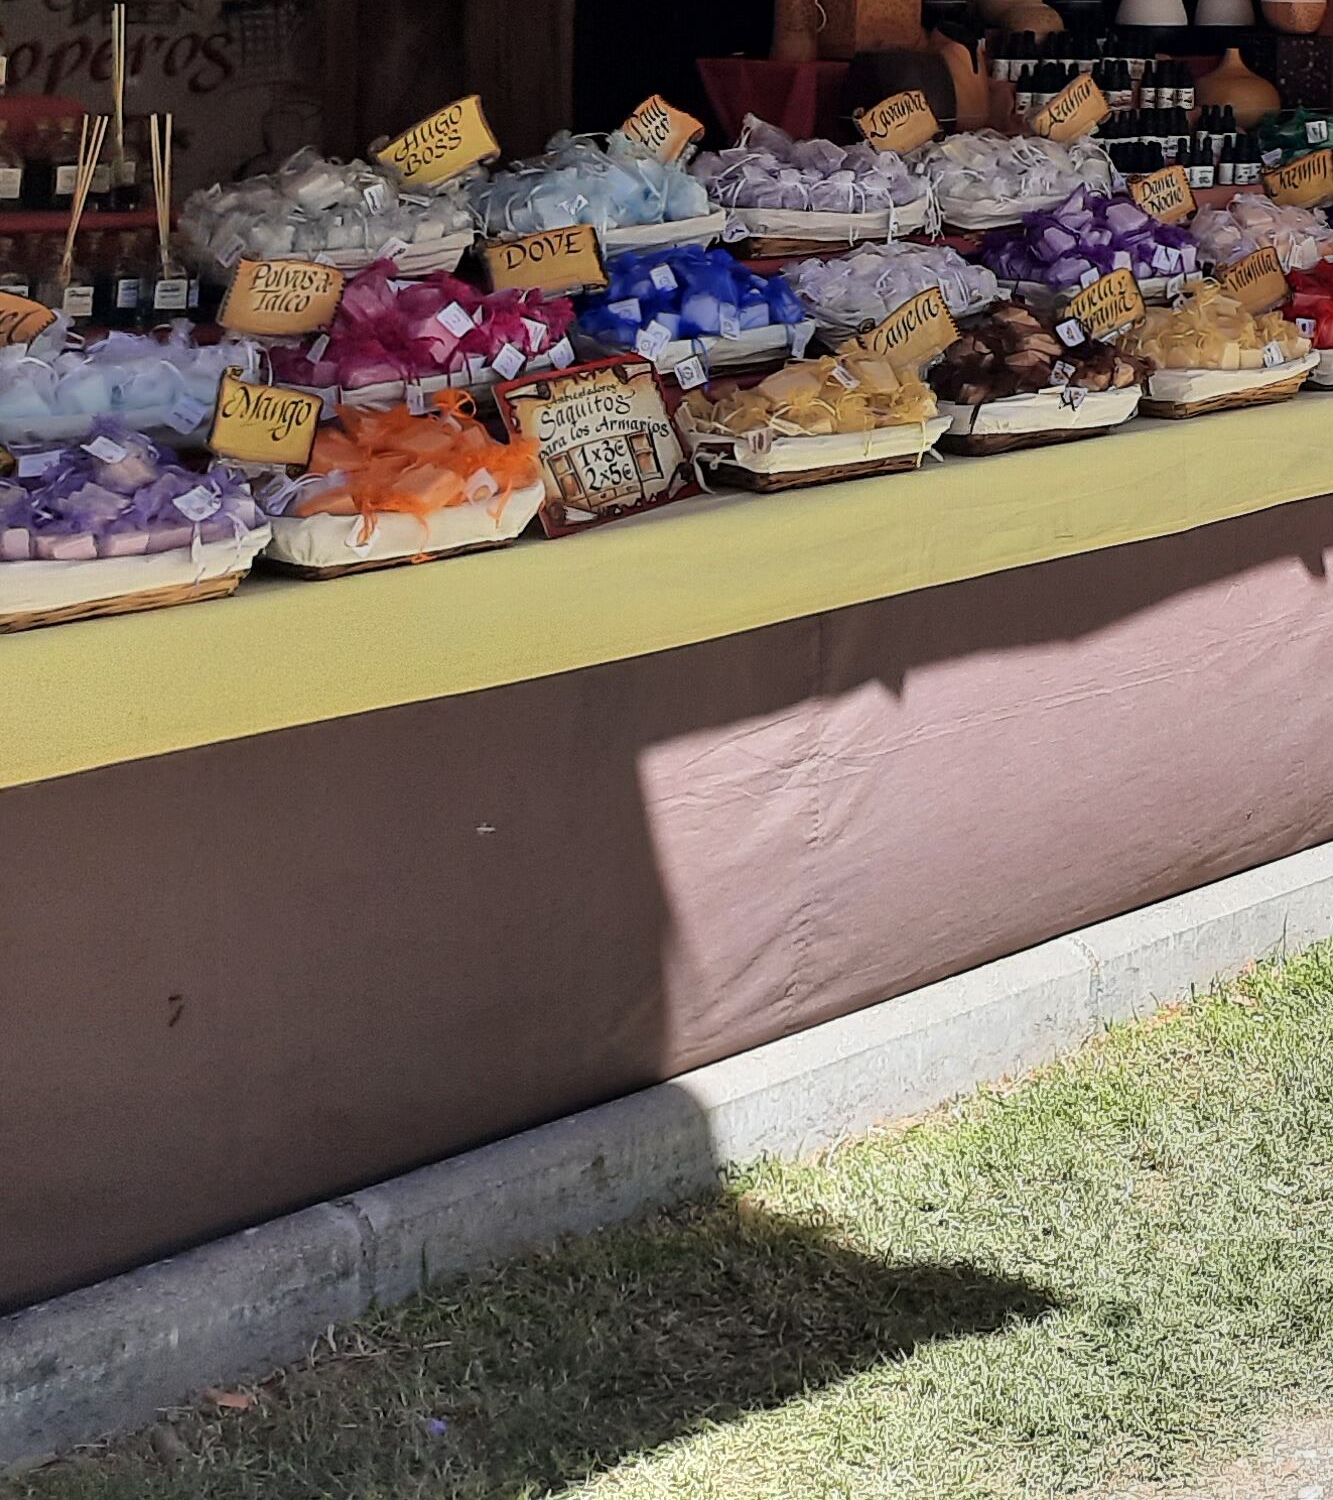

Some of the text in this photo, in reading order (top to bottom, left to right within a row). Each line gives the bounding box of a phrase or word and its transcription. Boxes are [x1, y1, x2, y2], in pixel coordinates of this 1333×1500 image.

[394, 105, 462, 162] HUGO
[404, 129, 462, 177] BOSS
[500, 231, 583, 270] DOVE
[249, 263, 317, 291] Polvos
[253, 289, 310, 313] Talco
[873, 293, 940, 355] Canela
[222, 386, 312, 442] Mango
[539, 390, 635, 442] Saquitos
[571, 424, 590, 441] los
[595, 415, 670, 438] Armarios
